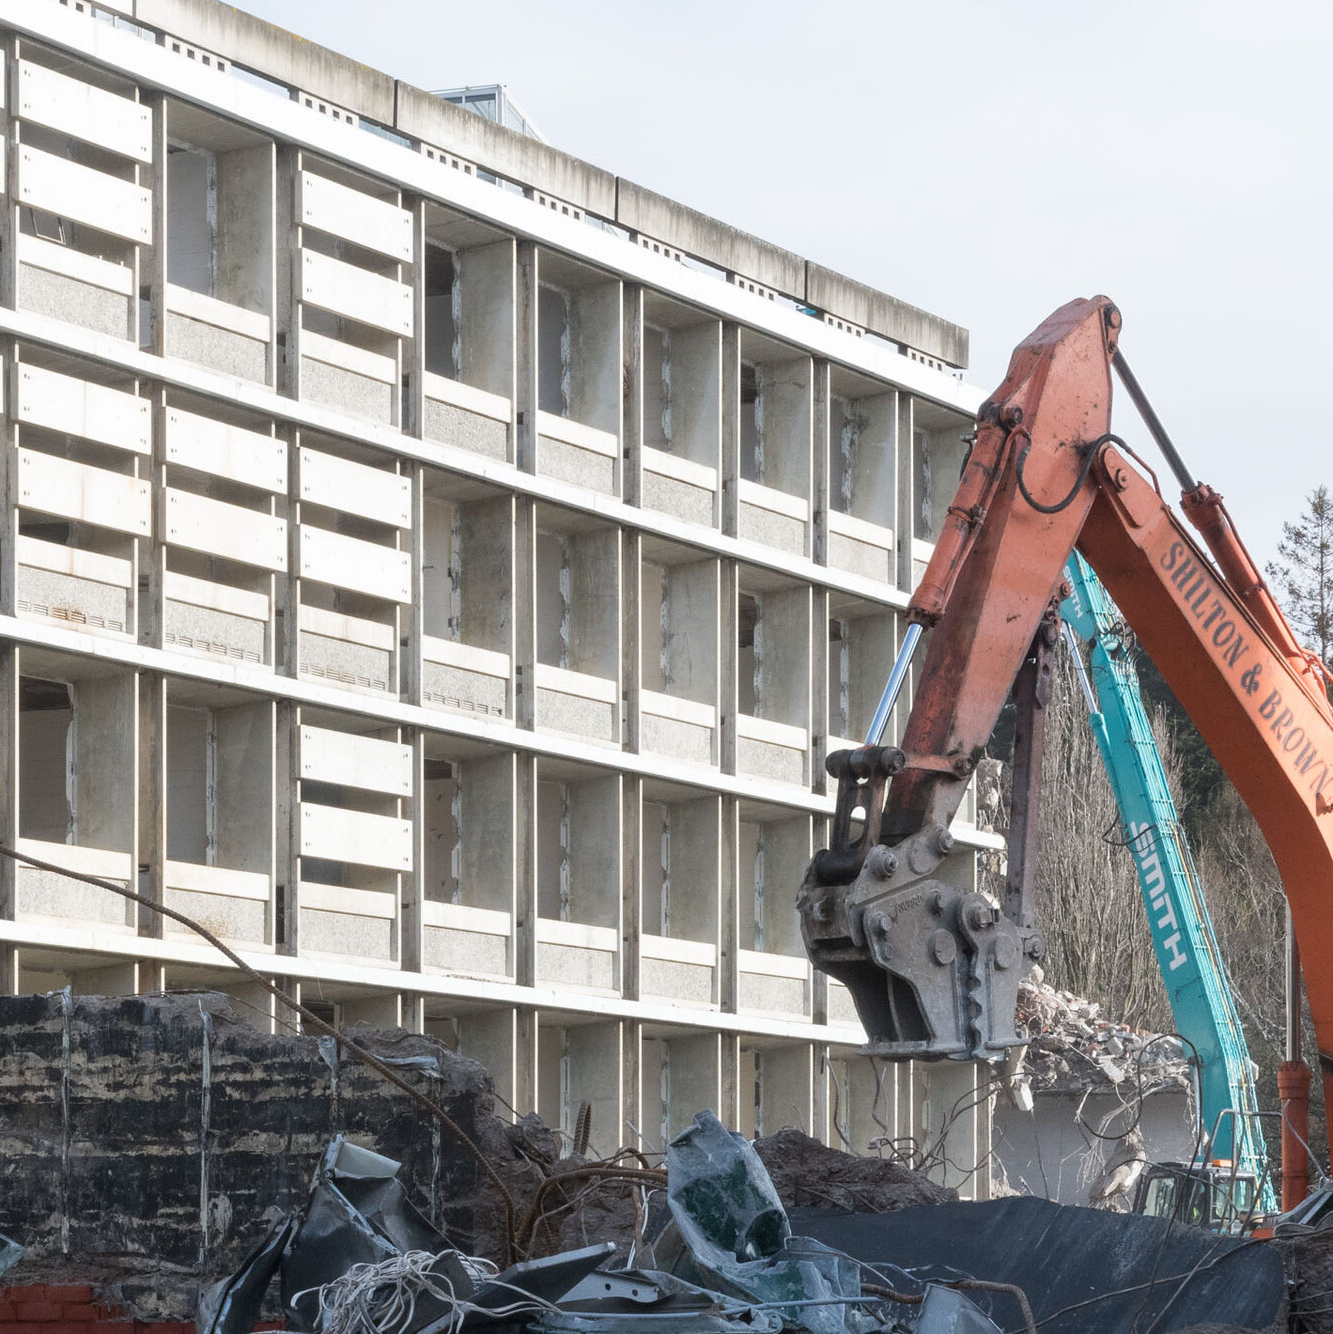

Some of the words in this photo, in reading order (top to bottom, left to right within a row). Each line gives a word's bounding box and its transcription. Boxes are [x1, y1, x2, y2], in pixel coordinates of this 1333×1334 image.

[1160, 542, 1249, 668] SHILTON
[1240, 662, 1264, 697] &
[1130, 820, 1188, 971] SMITH
